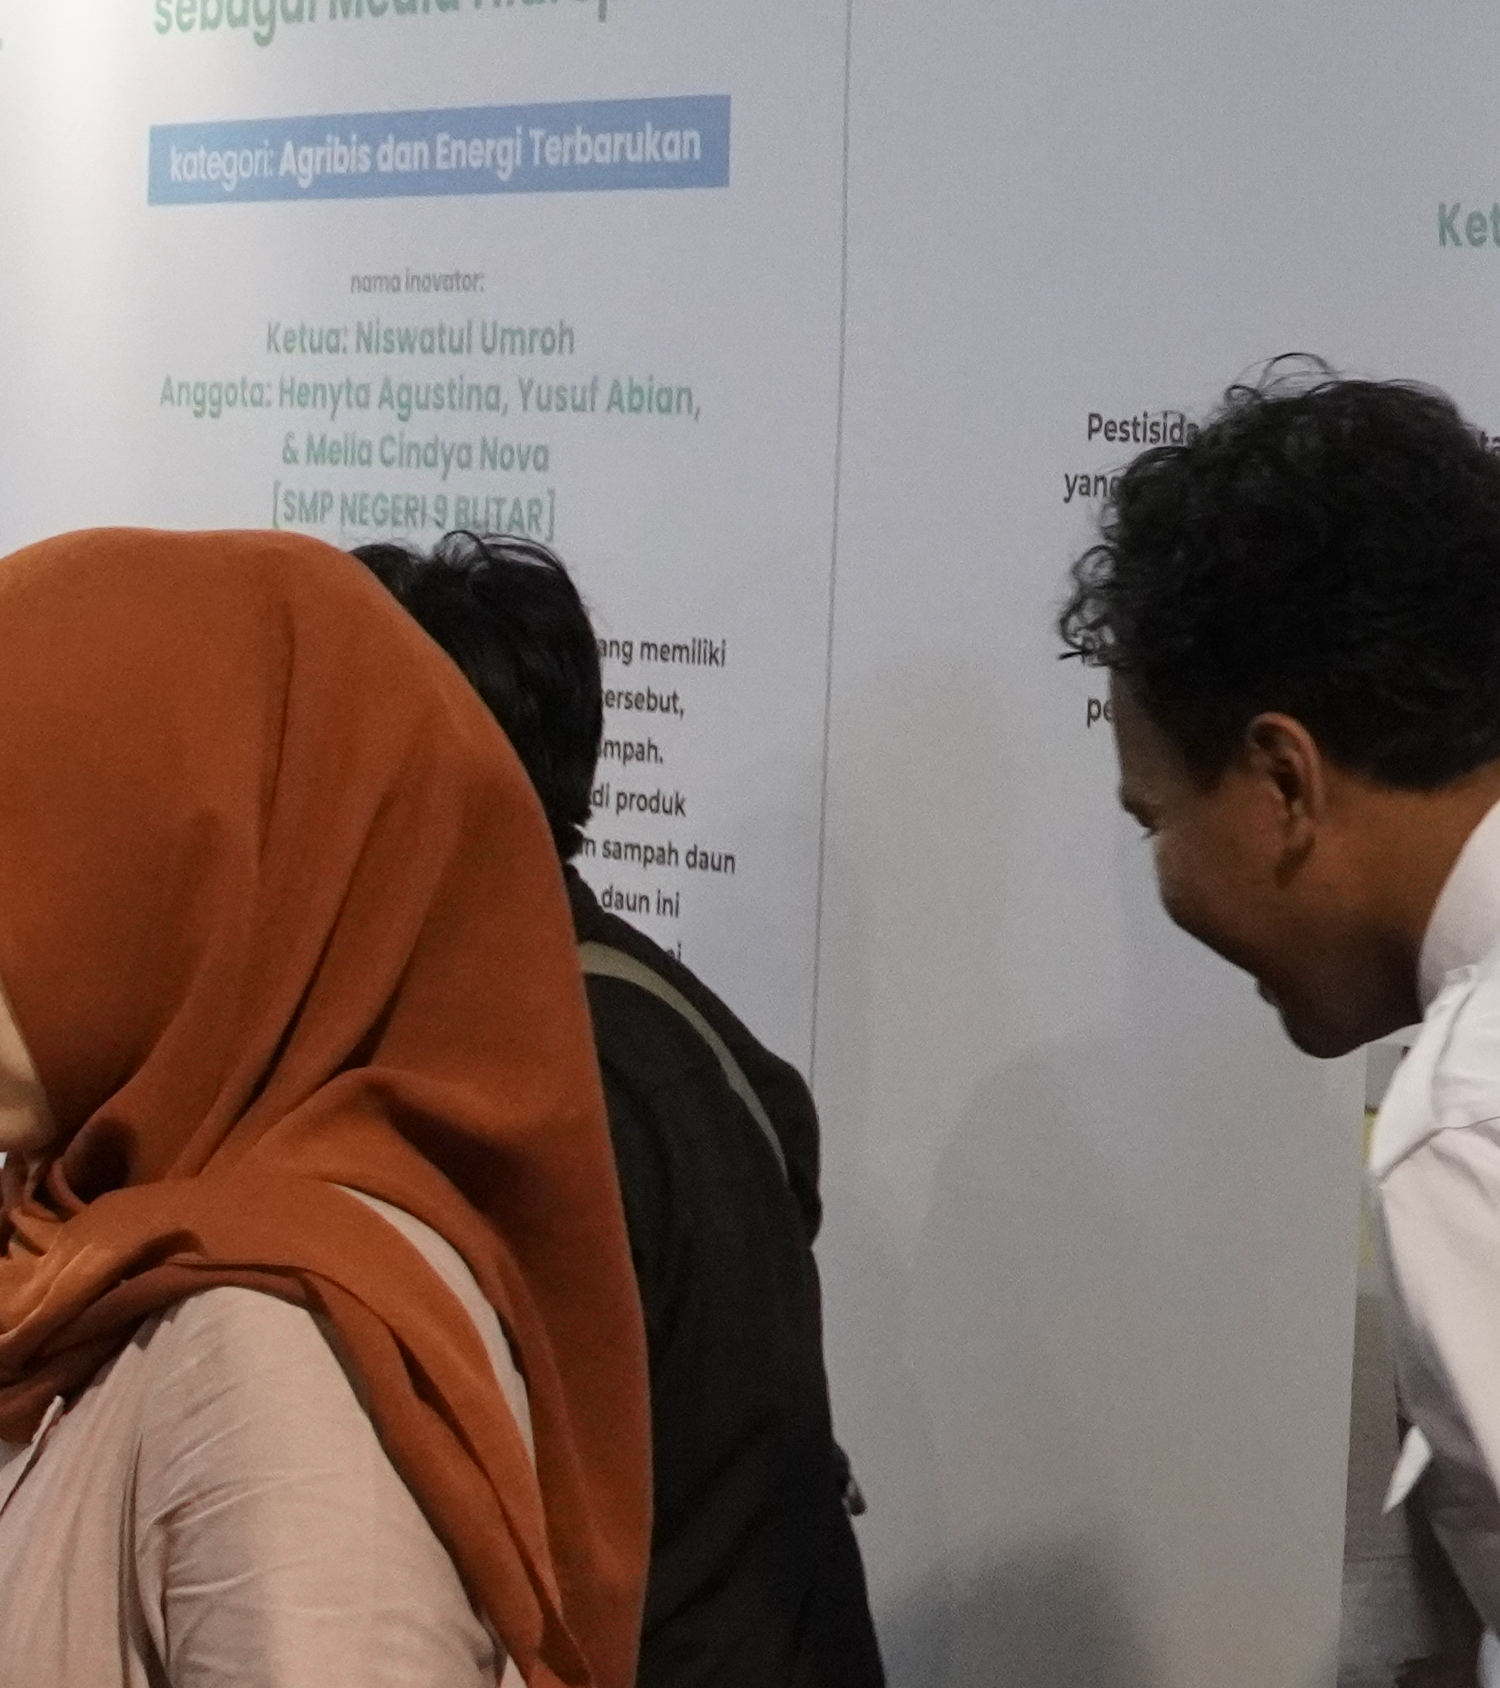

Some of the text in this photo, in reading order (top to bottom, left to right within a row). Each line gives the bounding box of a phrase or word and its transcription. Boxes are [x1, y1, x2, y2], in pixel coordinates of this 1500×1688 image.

[169, 121, 702, 191] kategori: Agribis dan Energi Terbarukan
[266, 317, 575, 357] Ketua: Niswatul Umroh
[158, 373, 273, 420] Anggota:
[278, 375, 372, 421] Henyta
[516, 375, 598, 415] Yusuf
[604, 375, 702, 422] Abian,
[282, 430, 300, 467] &
[478, 433, 550, 473] Nova
[339, 488, 430, 530] NEGERI
[599, 636, 727, 668] ang memiliki
[600, 685, 685, 721] ersebut,
[599, 736, 664, 765] mpah.
[615, 787, 687, 818] produk
[601, 837, 737, 875] sampah daun
[601, 883, 681, 919] daun ini
